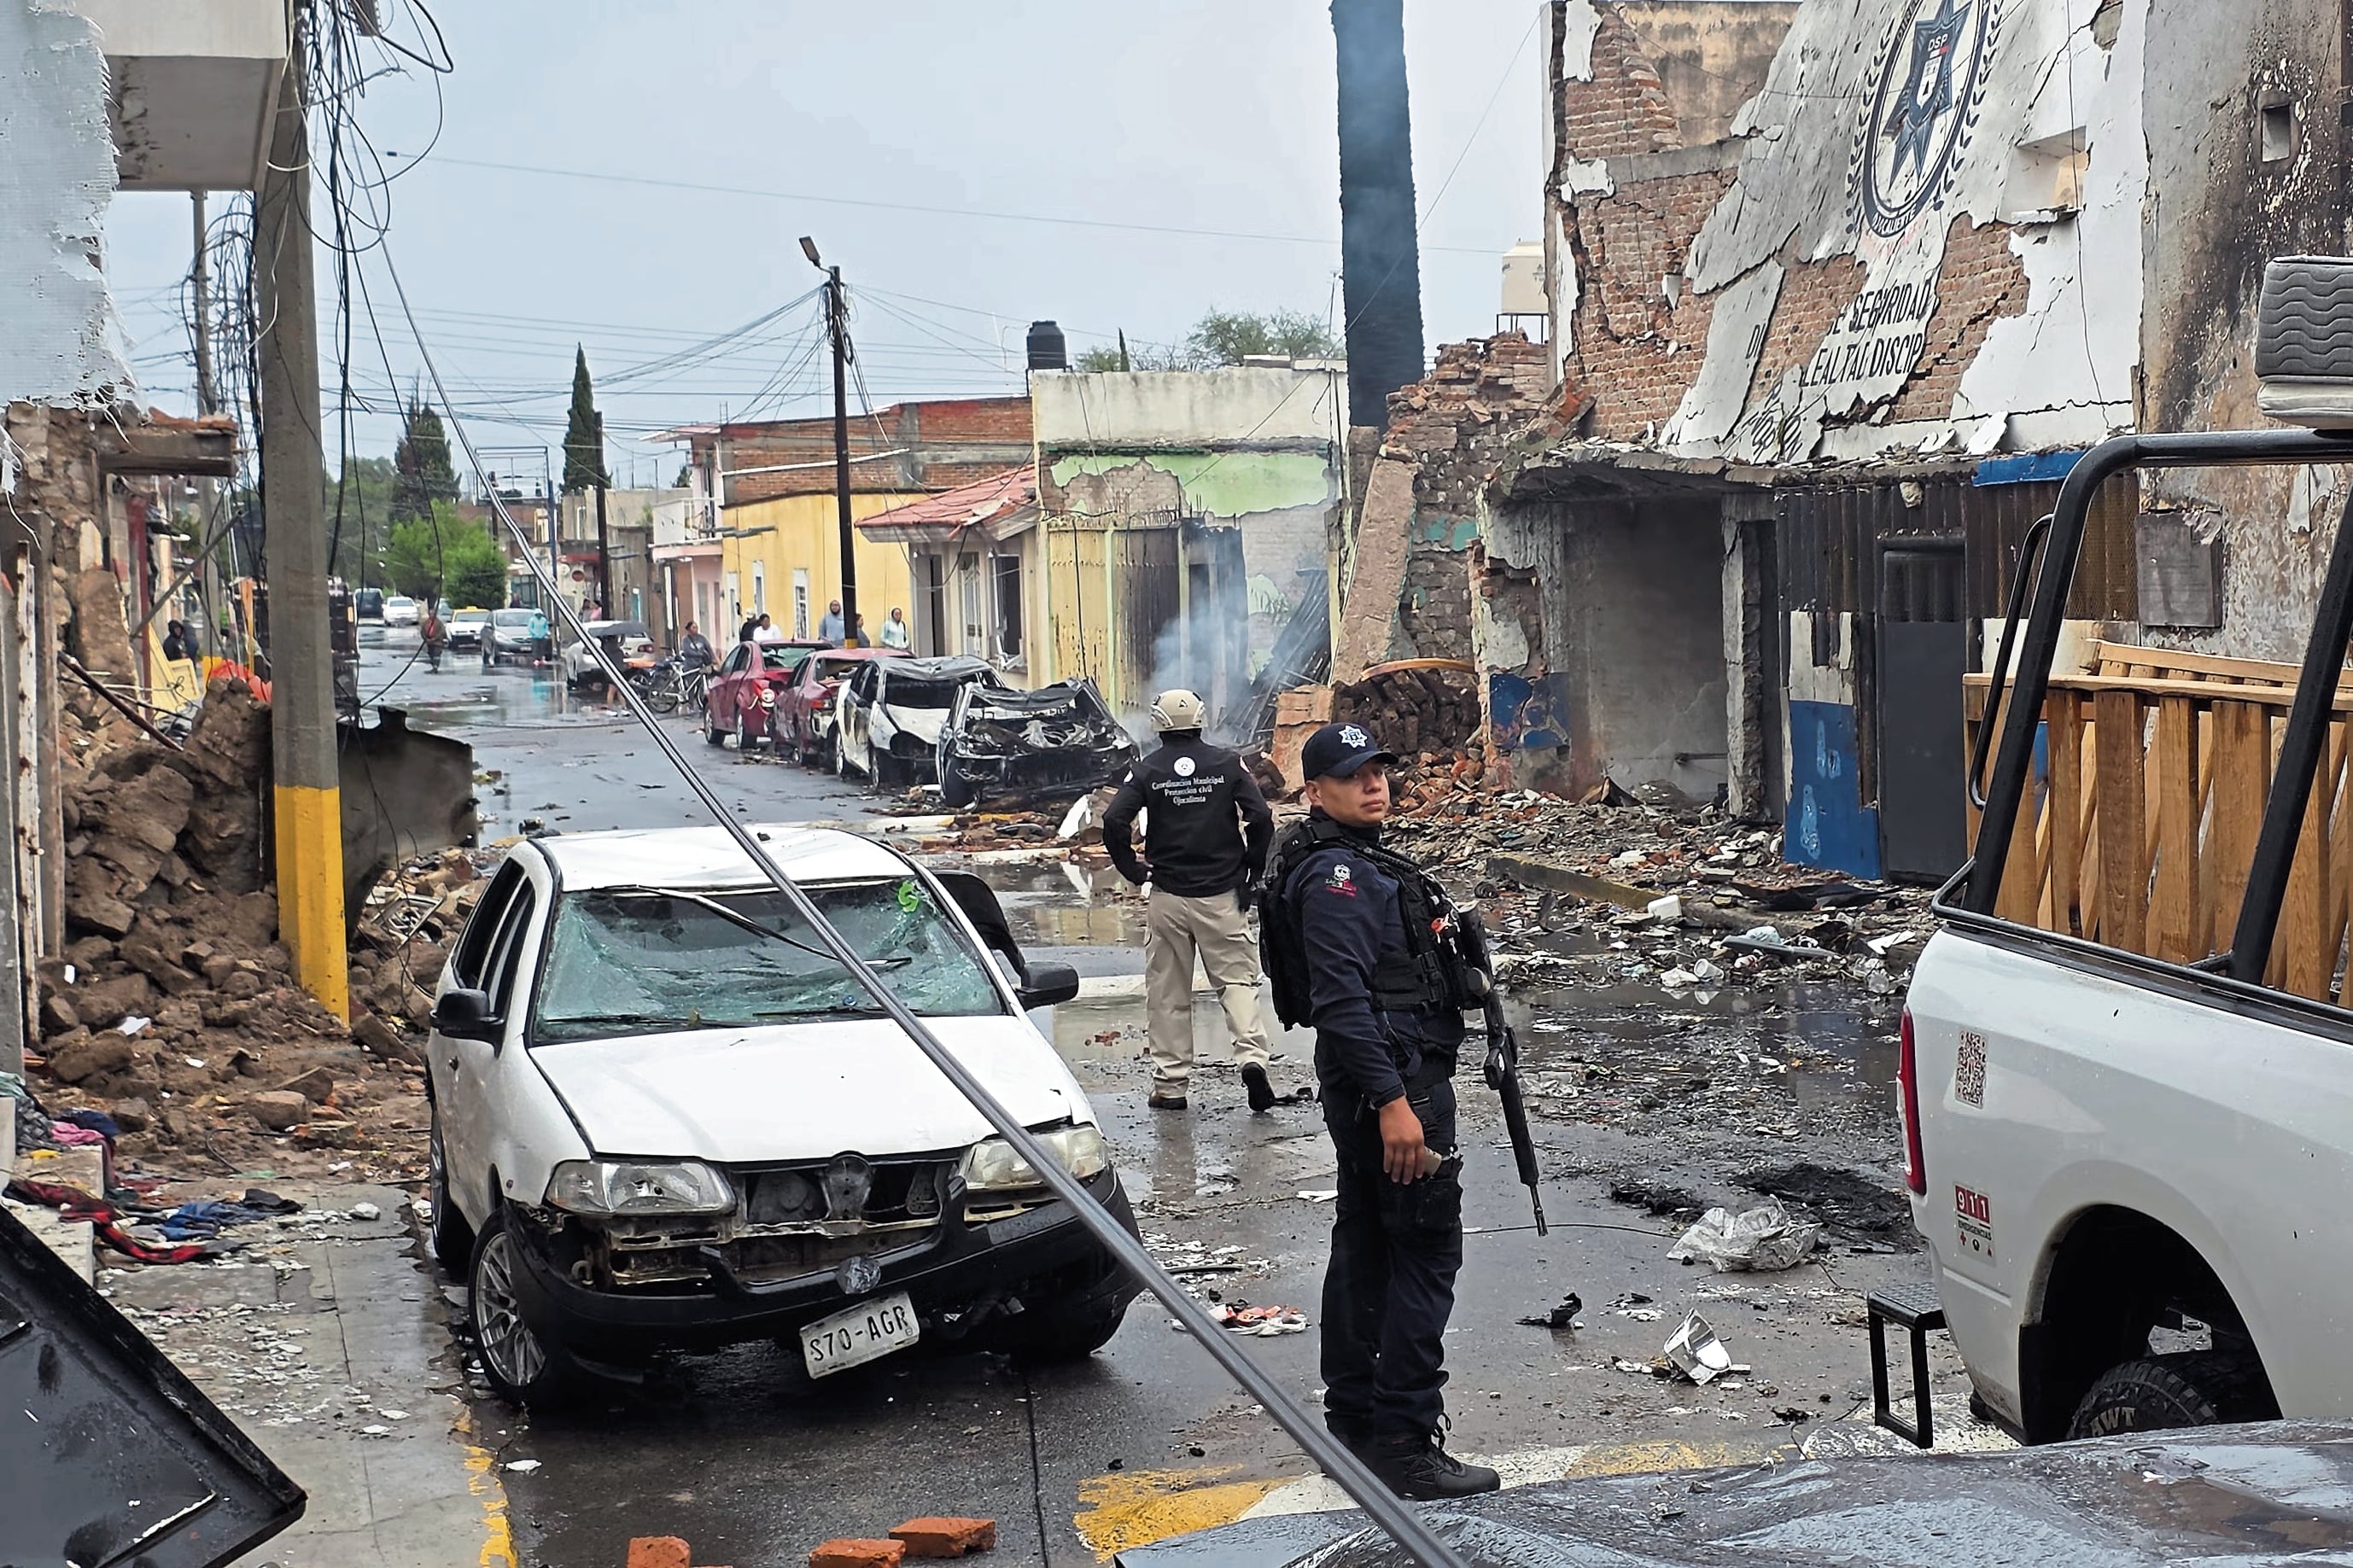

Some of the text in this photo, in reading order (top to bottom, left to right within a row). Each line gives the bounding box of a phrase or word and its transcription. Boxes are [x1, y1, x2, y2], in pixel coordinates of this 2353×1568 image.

[1927, 33, 1948, 52] DSP
[1745, 324, 1766, 359] DI
[1869, 332, 1924, 378] DISCIP
[1193, 775, 1224, 784] Municipal
[1958, 1191, 1987, 1219] 911
[809, 1305, 909, 1361] S70-AGR
